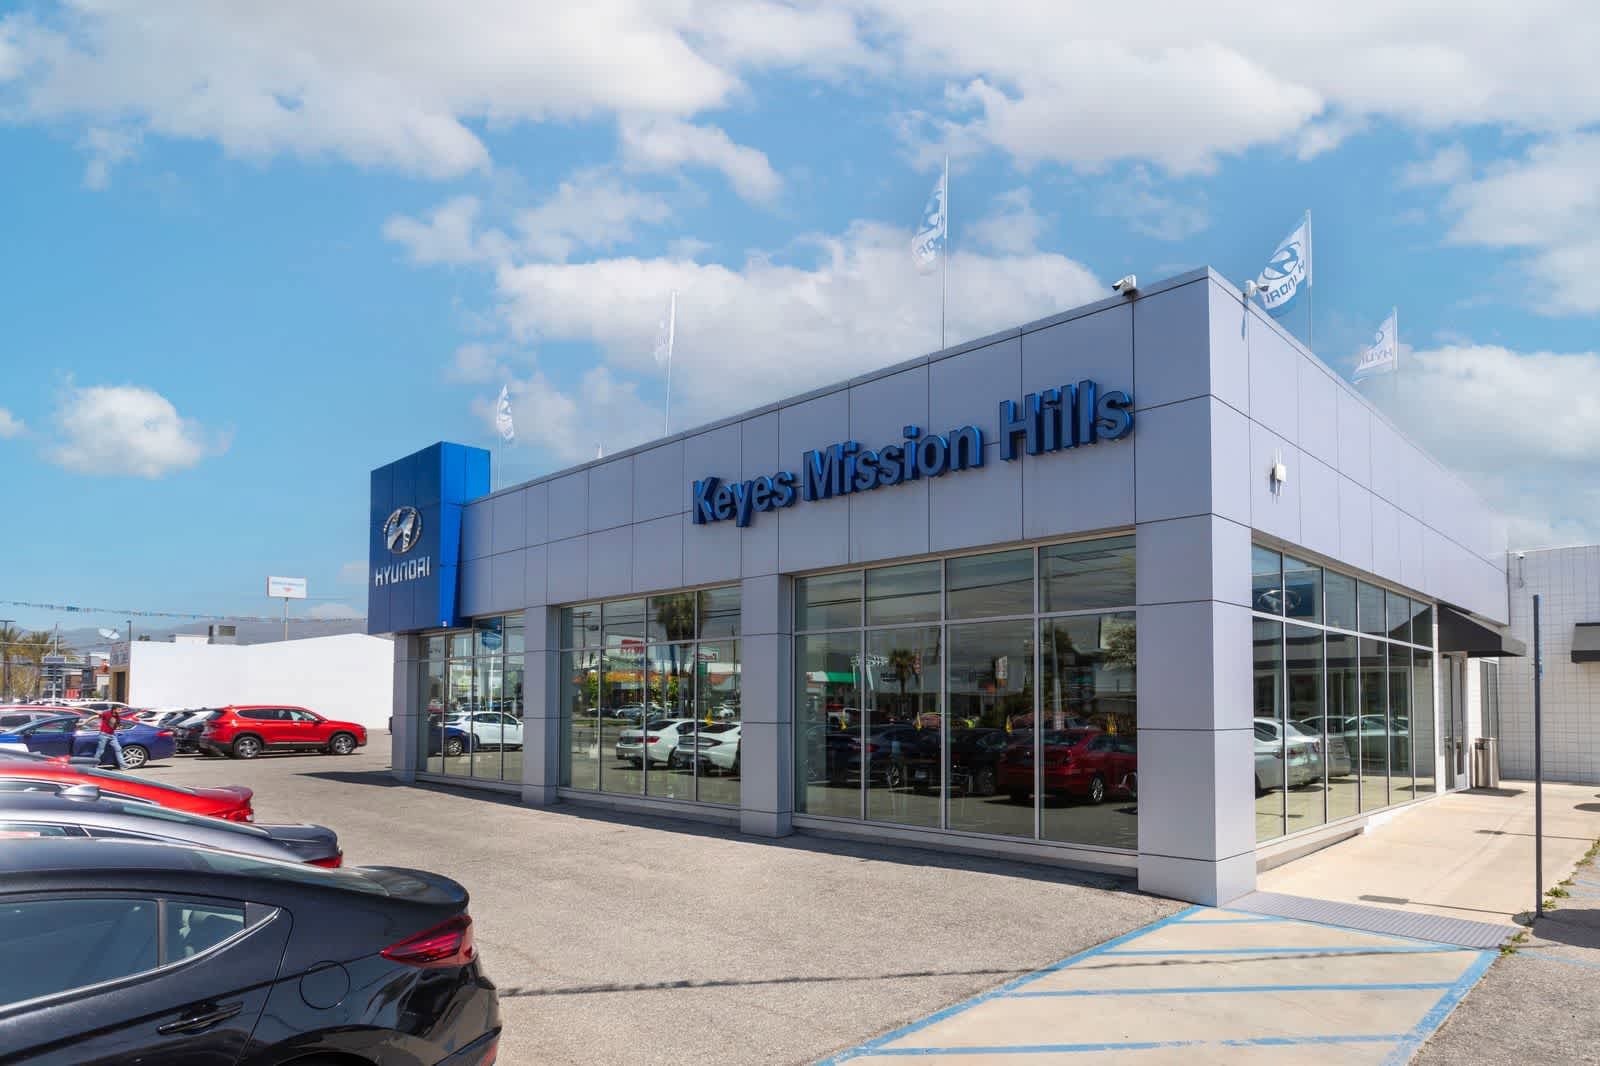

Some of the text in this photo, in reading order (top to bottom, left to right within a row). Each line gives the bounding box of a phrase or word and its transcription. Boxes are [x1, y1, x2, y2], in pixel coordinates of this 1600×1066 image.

[693, 380, 1133, 527] Keyes Mission Hills
[375, 555, 430, 587] HYUNDAI
